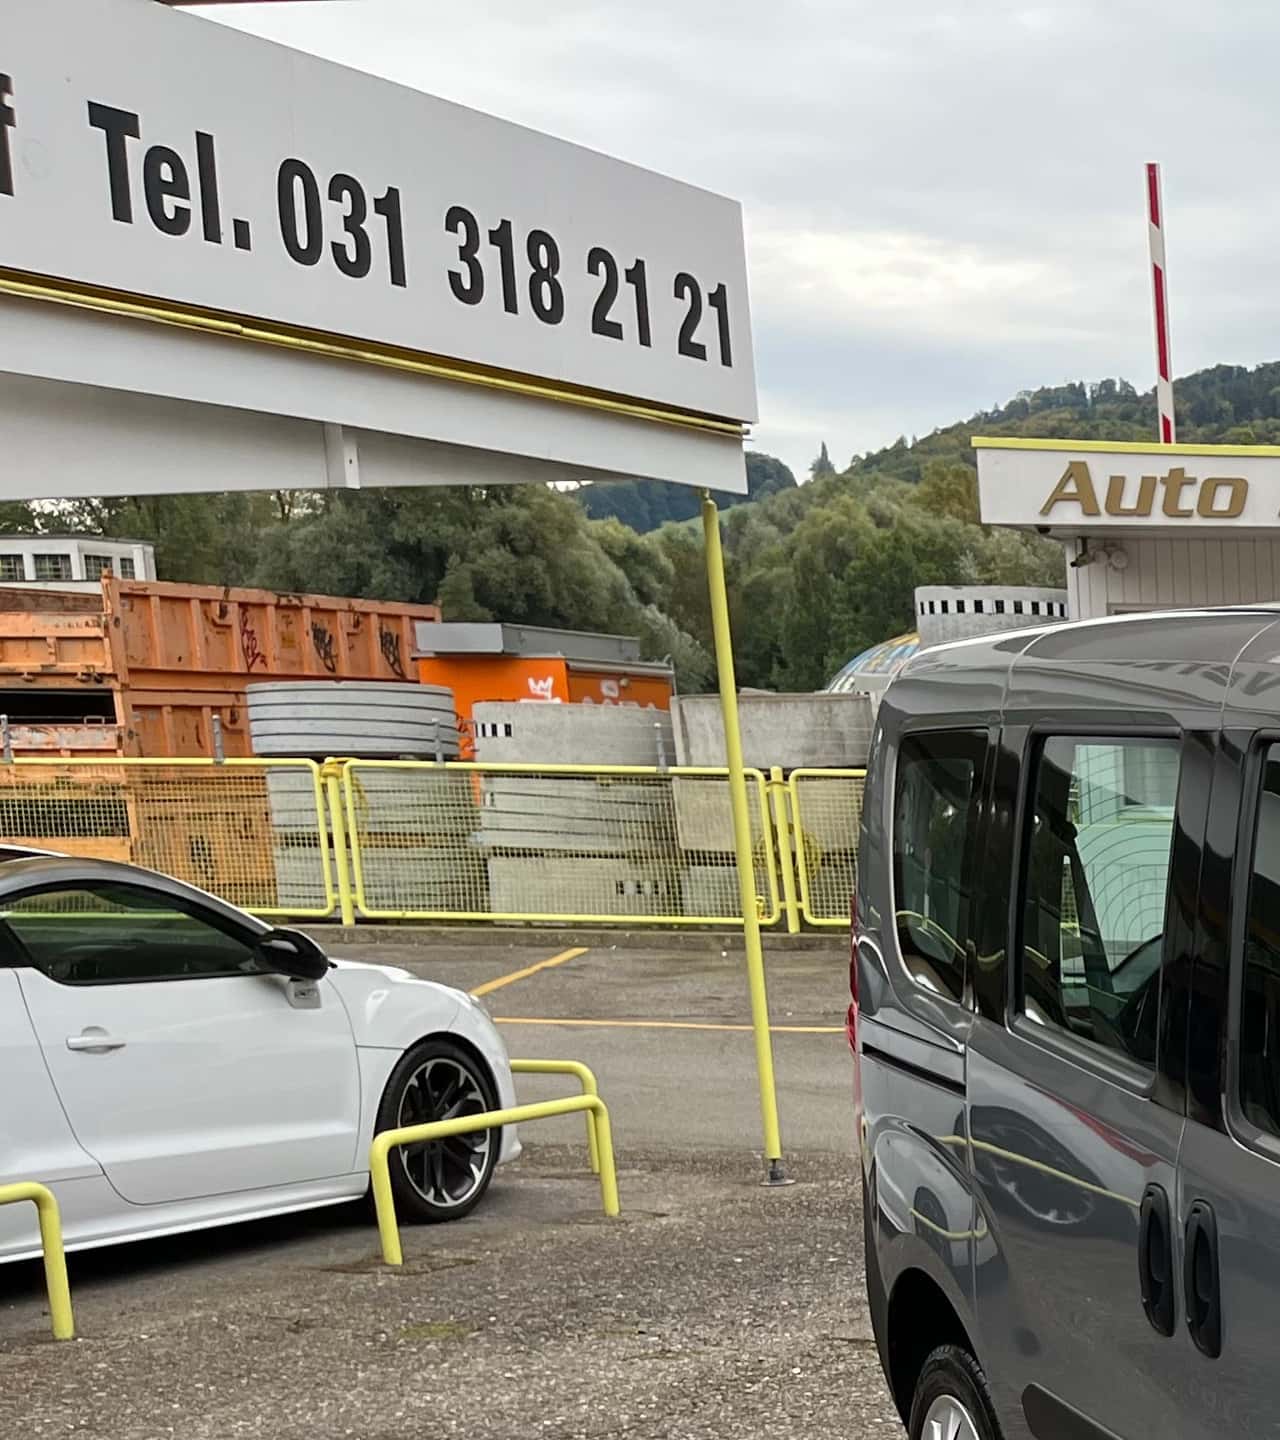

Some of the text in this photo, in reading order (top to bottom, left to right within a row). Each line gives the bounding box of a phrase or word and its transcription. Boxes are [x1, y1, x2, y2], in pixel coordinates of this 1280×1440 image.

[87, 100, 252, 252] Tel.
[277, 157, 407, 290] 031
[444, 205, 565, 326] 318
[586, 246, 652, 349] 21
[673, 271, 734, 368] 21
[1040, 460, 1249, 519] Auto
